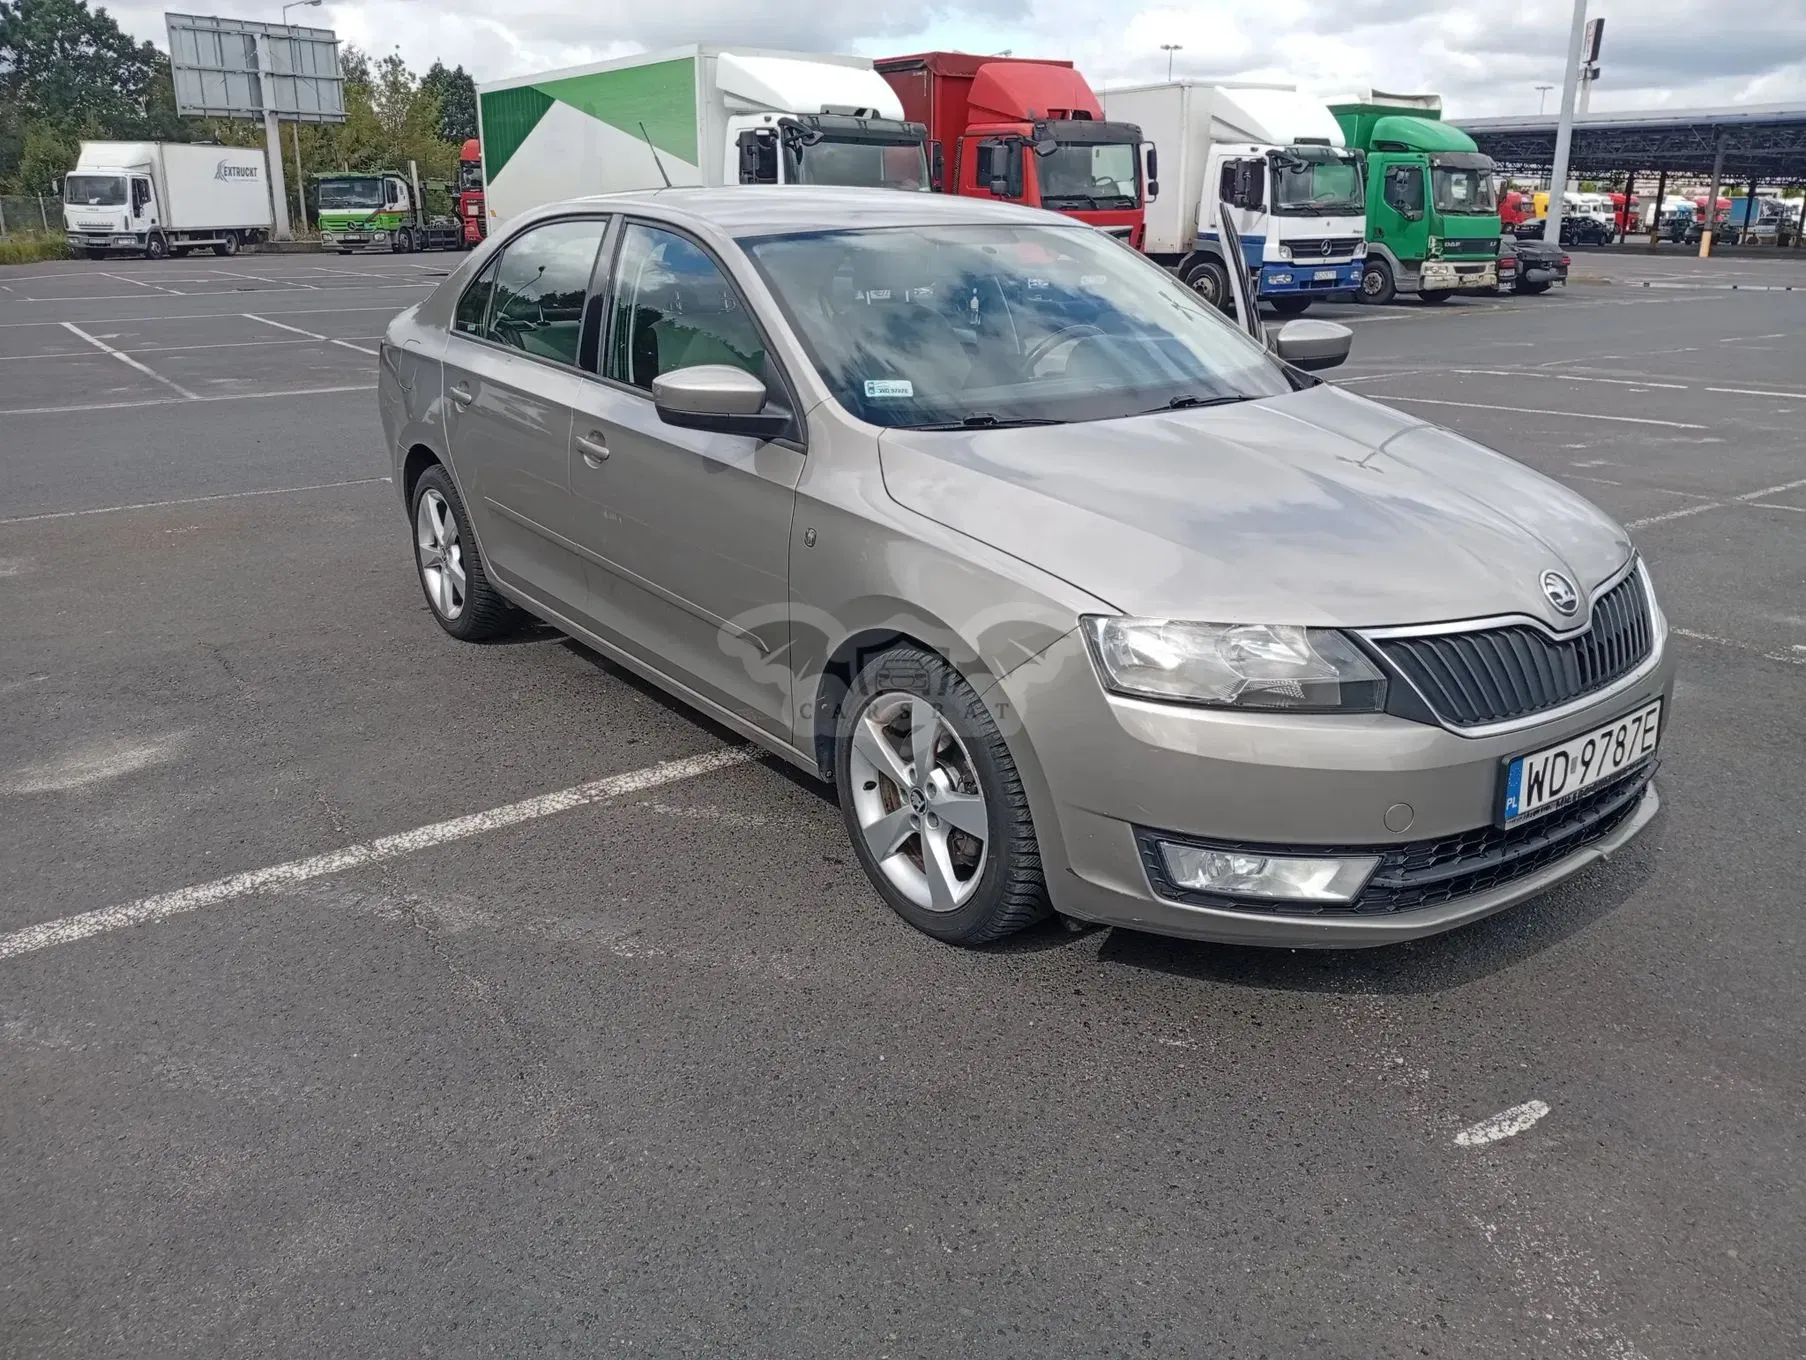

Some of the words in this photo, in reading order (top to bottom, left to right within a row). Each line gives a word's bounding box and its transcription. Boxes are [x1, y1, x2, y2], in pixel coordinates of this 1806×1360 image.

[223, 166, 258, 177] EXTRUCKT
[1526, 750, 1570, 807] WD
[1578, 707, 1658, 785] 9787E
[1506, 796, 1518, 811] PL
